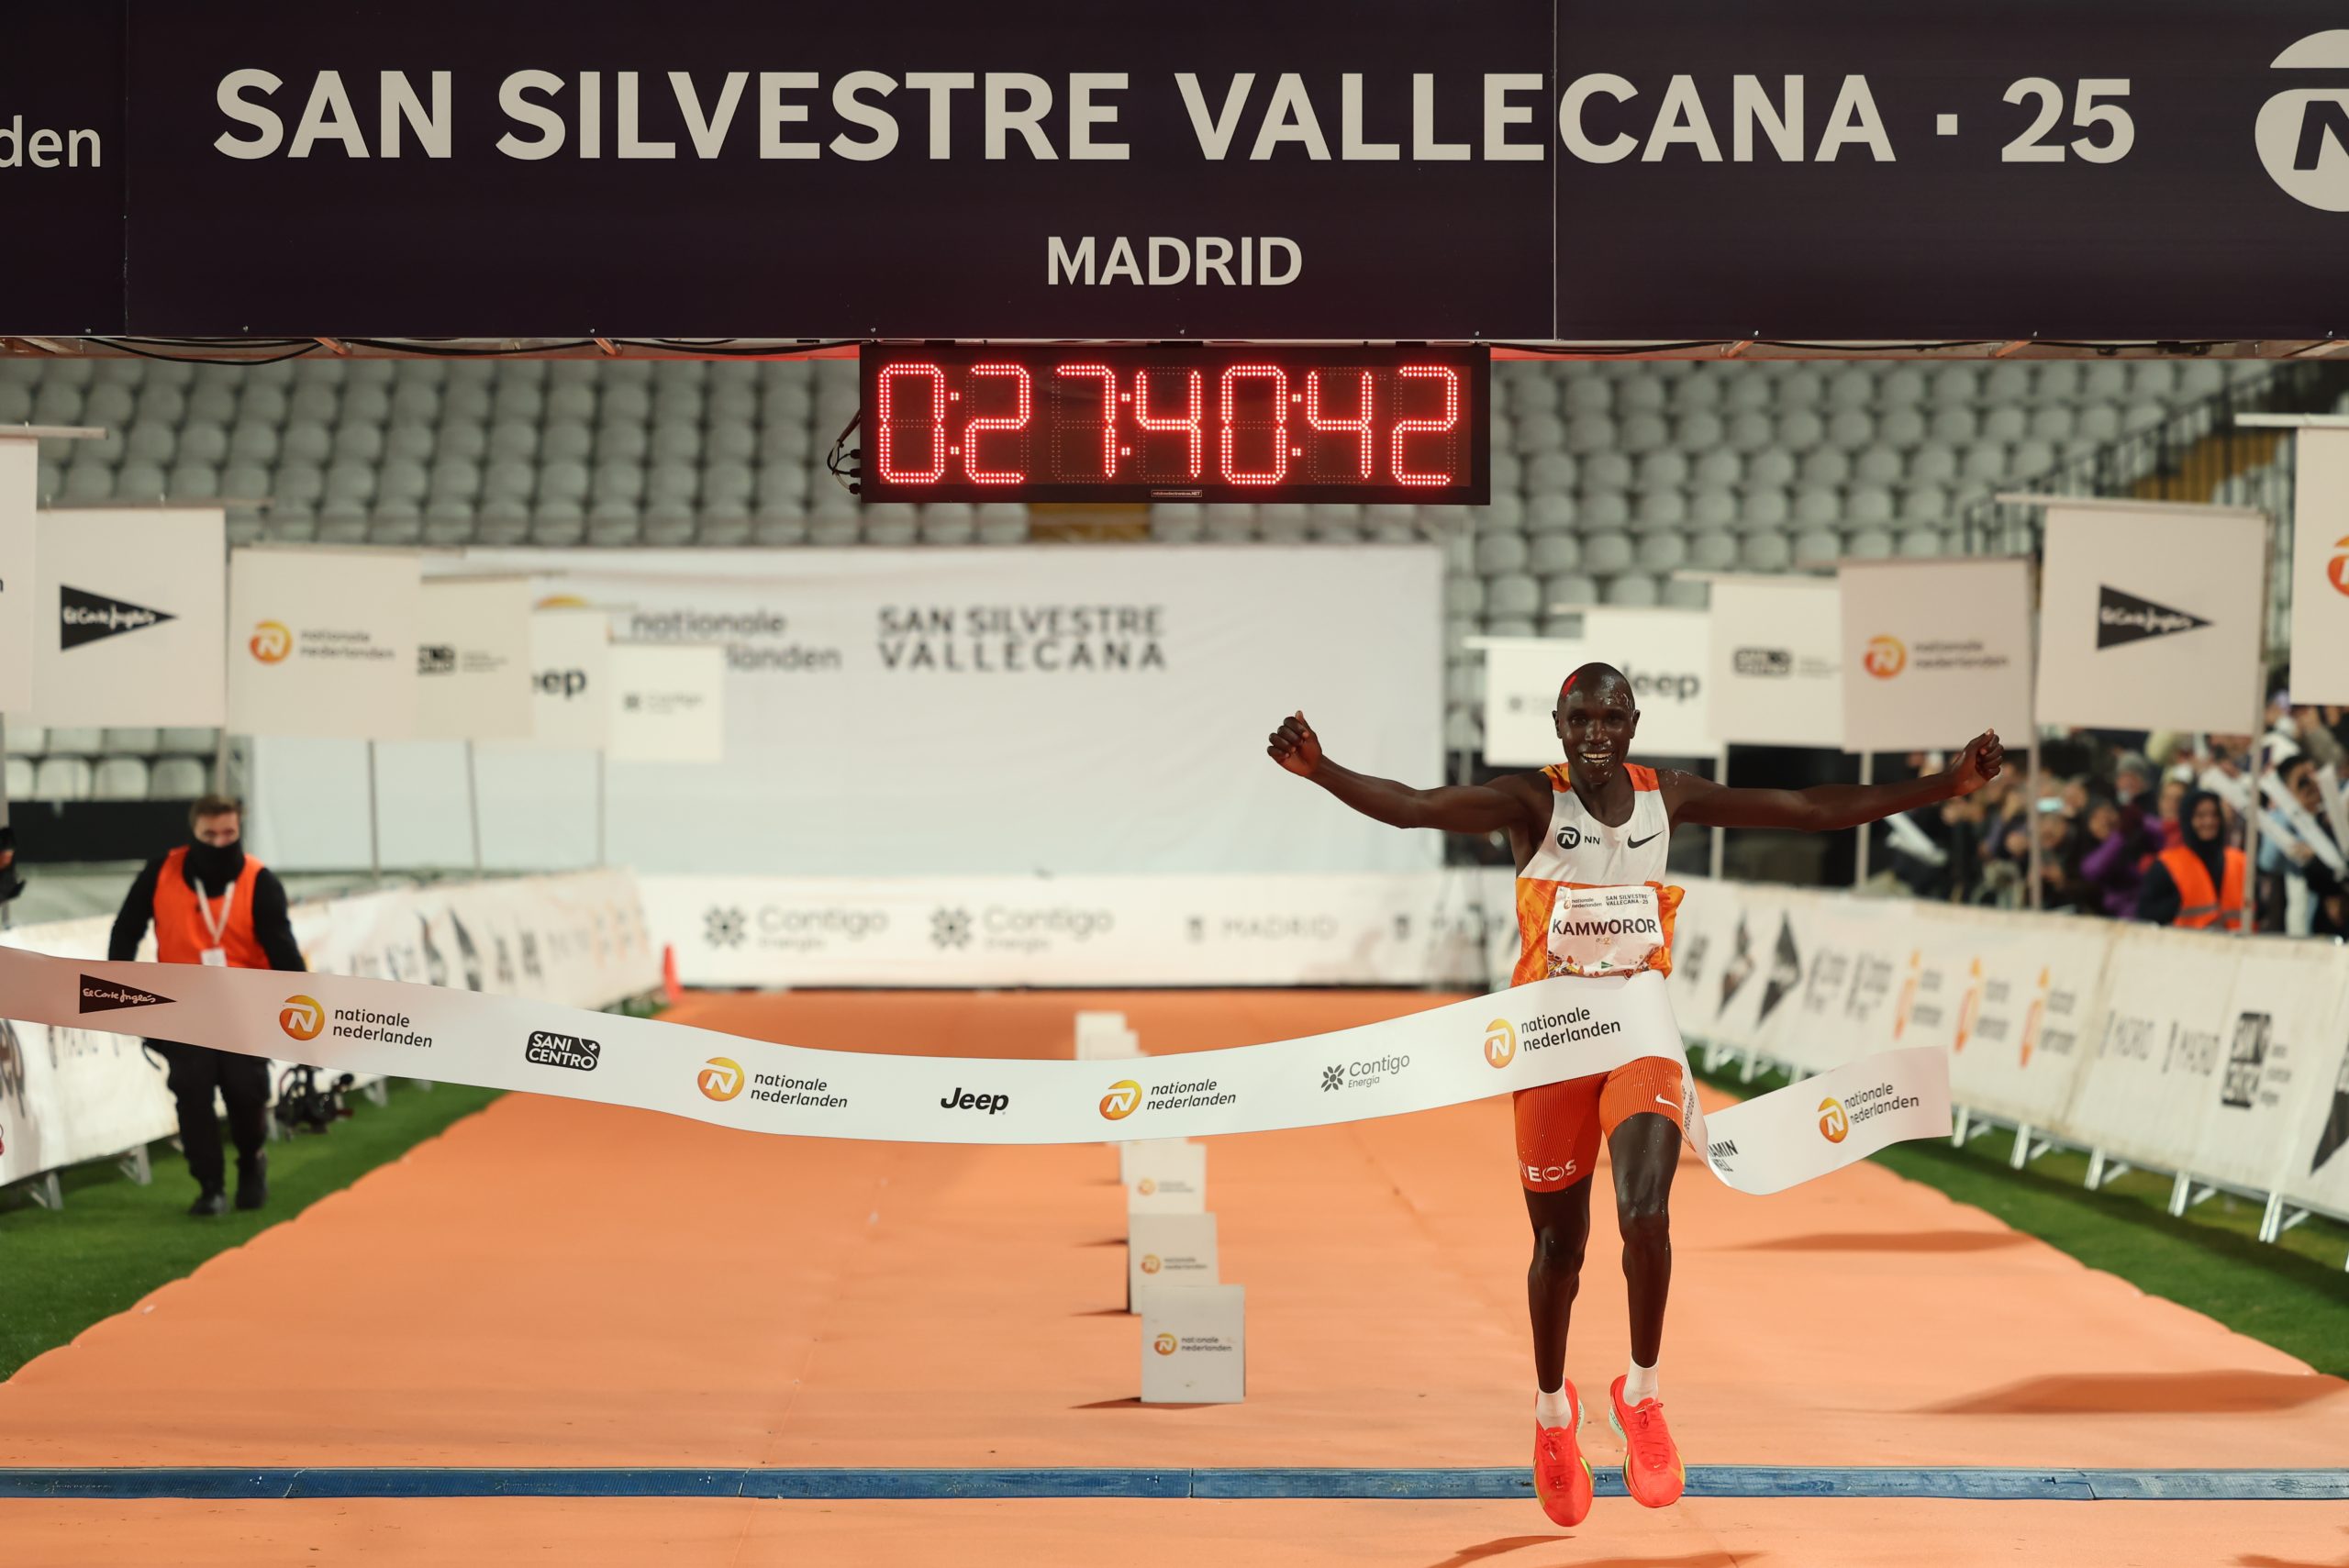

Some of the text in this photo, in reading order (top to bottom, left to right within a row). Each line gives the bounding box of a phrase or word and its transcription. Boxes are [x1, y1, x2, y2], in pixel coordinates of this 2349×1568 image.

[214, 69, 451, 160] SAN
[495, 70, 1130, 161] SILVESTRE
[1174, 72, 1896, 163] VALLECANA
[2001, 77, 2135, 163] 25
[1047, 236, 1302, 286] MADRID
[629, 609, 786, 638] nationale
[878, 607, 1165, 636] SAN SILVESTRE
[725, 640, 843, 672] landen
[878, 641, 1167, 670] VALLECANA
[1584, 836, 1600, 845] NN
[759, 908, 887, 940] Contigo
[985, 908, 1114, 941] Contigo
[1552, 917, 1658, 936] KAMWOROR
[83, 988, 94, 997] El
[95, 990, 118, 999] Corte
[335, 1008, 410, 1029] nationale
[1521, 1006, 1591, 1034] nationale
[333, 1023, 432, 1049] nederlanden
[532, 1033, 573, 1052] SANI
[1523, 1019, 1621, 1052] nederlanden
[529, 1048, 595, 1069] CENTRO
[1349, 1054, 1410, 1077] Contigo
[754, 1073, 828, 1092] nationale
[1151, 1079, 1218, 1095] nationale
[751, 1088, 848, 1109] nederlanden
[941, 1088, 1009, 1115] Jeep
[1147, 1093, 1237, 1111] nederlanden
[1843, 1083, 1893, 1110] nationale
[1850, 1095, 1920, 1126] nederlanden
[1708, 1140, 1739, 1158] AMIN
[1520, 1160, 1577, 1183] NEOS
